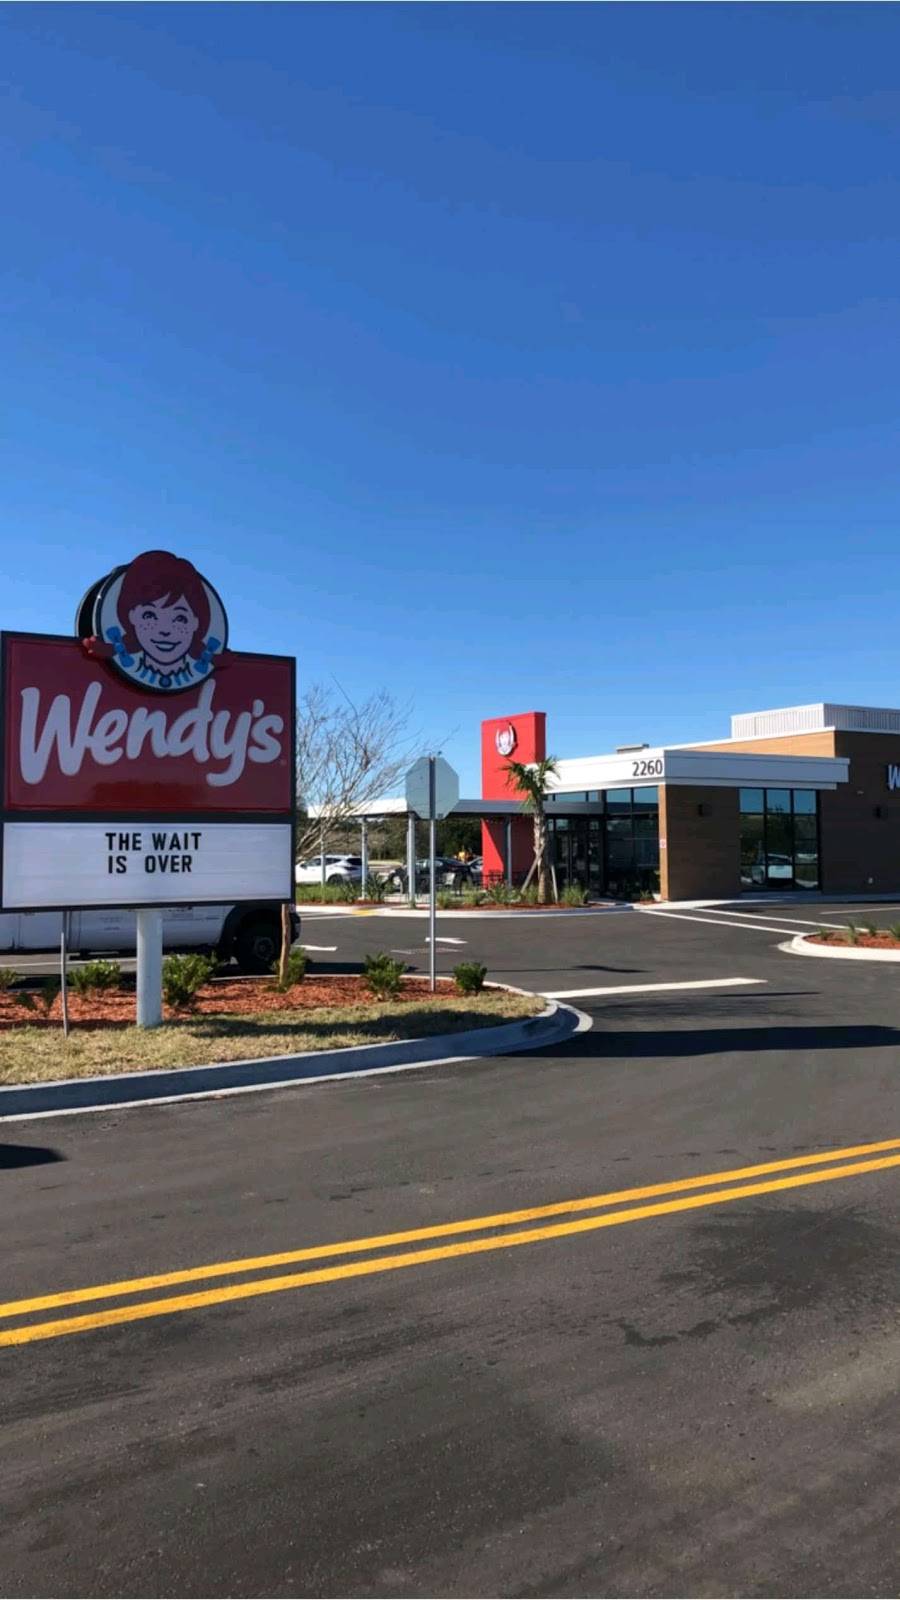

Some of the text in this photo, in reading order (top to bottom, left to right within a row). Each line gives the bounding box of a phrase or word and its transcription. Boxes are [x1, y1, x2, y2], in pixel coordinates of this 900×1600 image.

[20, 679, 284, 787] Wendy's
[632, 759, 663, 777] 2260
[105, 832, 202, 851] THE WAIT
[108, 855, 192, 874] IS OVER
